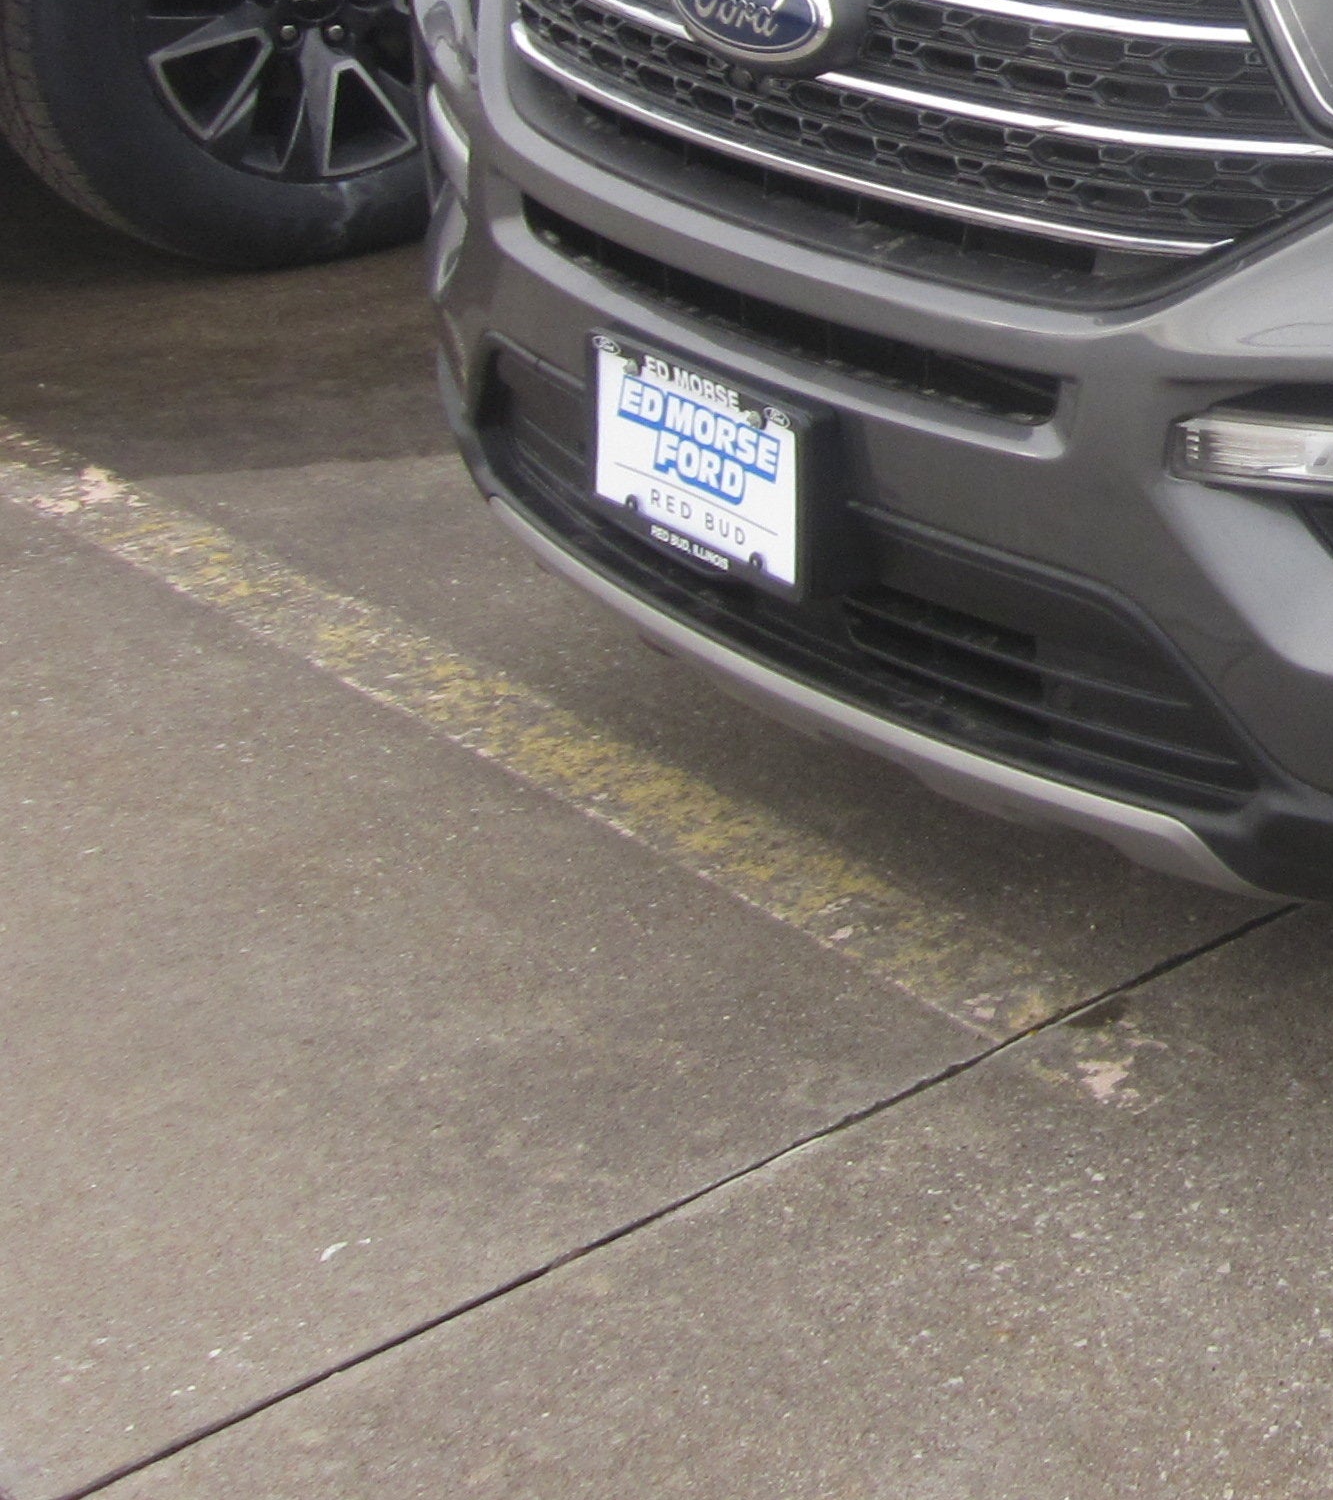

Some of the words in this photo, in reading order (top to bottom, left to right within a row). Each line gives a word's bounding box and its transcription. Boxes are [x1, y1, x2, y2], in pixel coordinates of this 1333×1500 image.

[642, 355, 670, 382] ED
[673, 367, 741, 412] MORSE
[619, 378, 664, 426] ED
[665, 393, 780, 479] MORSE
[655, 432, 745, 502] FORD
[650, 488, 692, 520] RED
[704, 512, 746, 546] BUD
